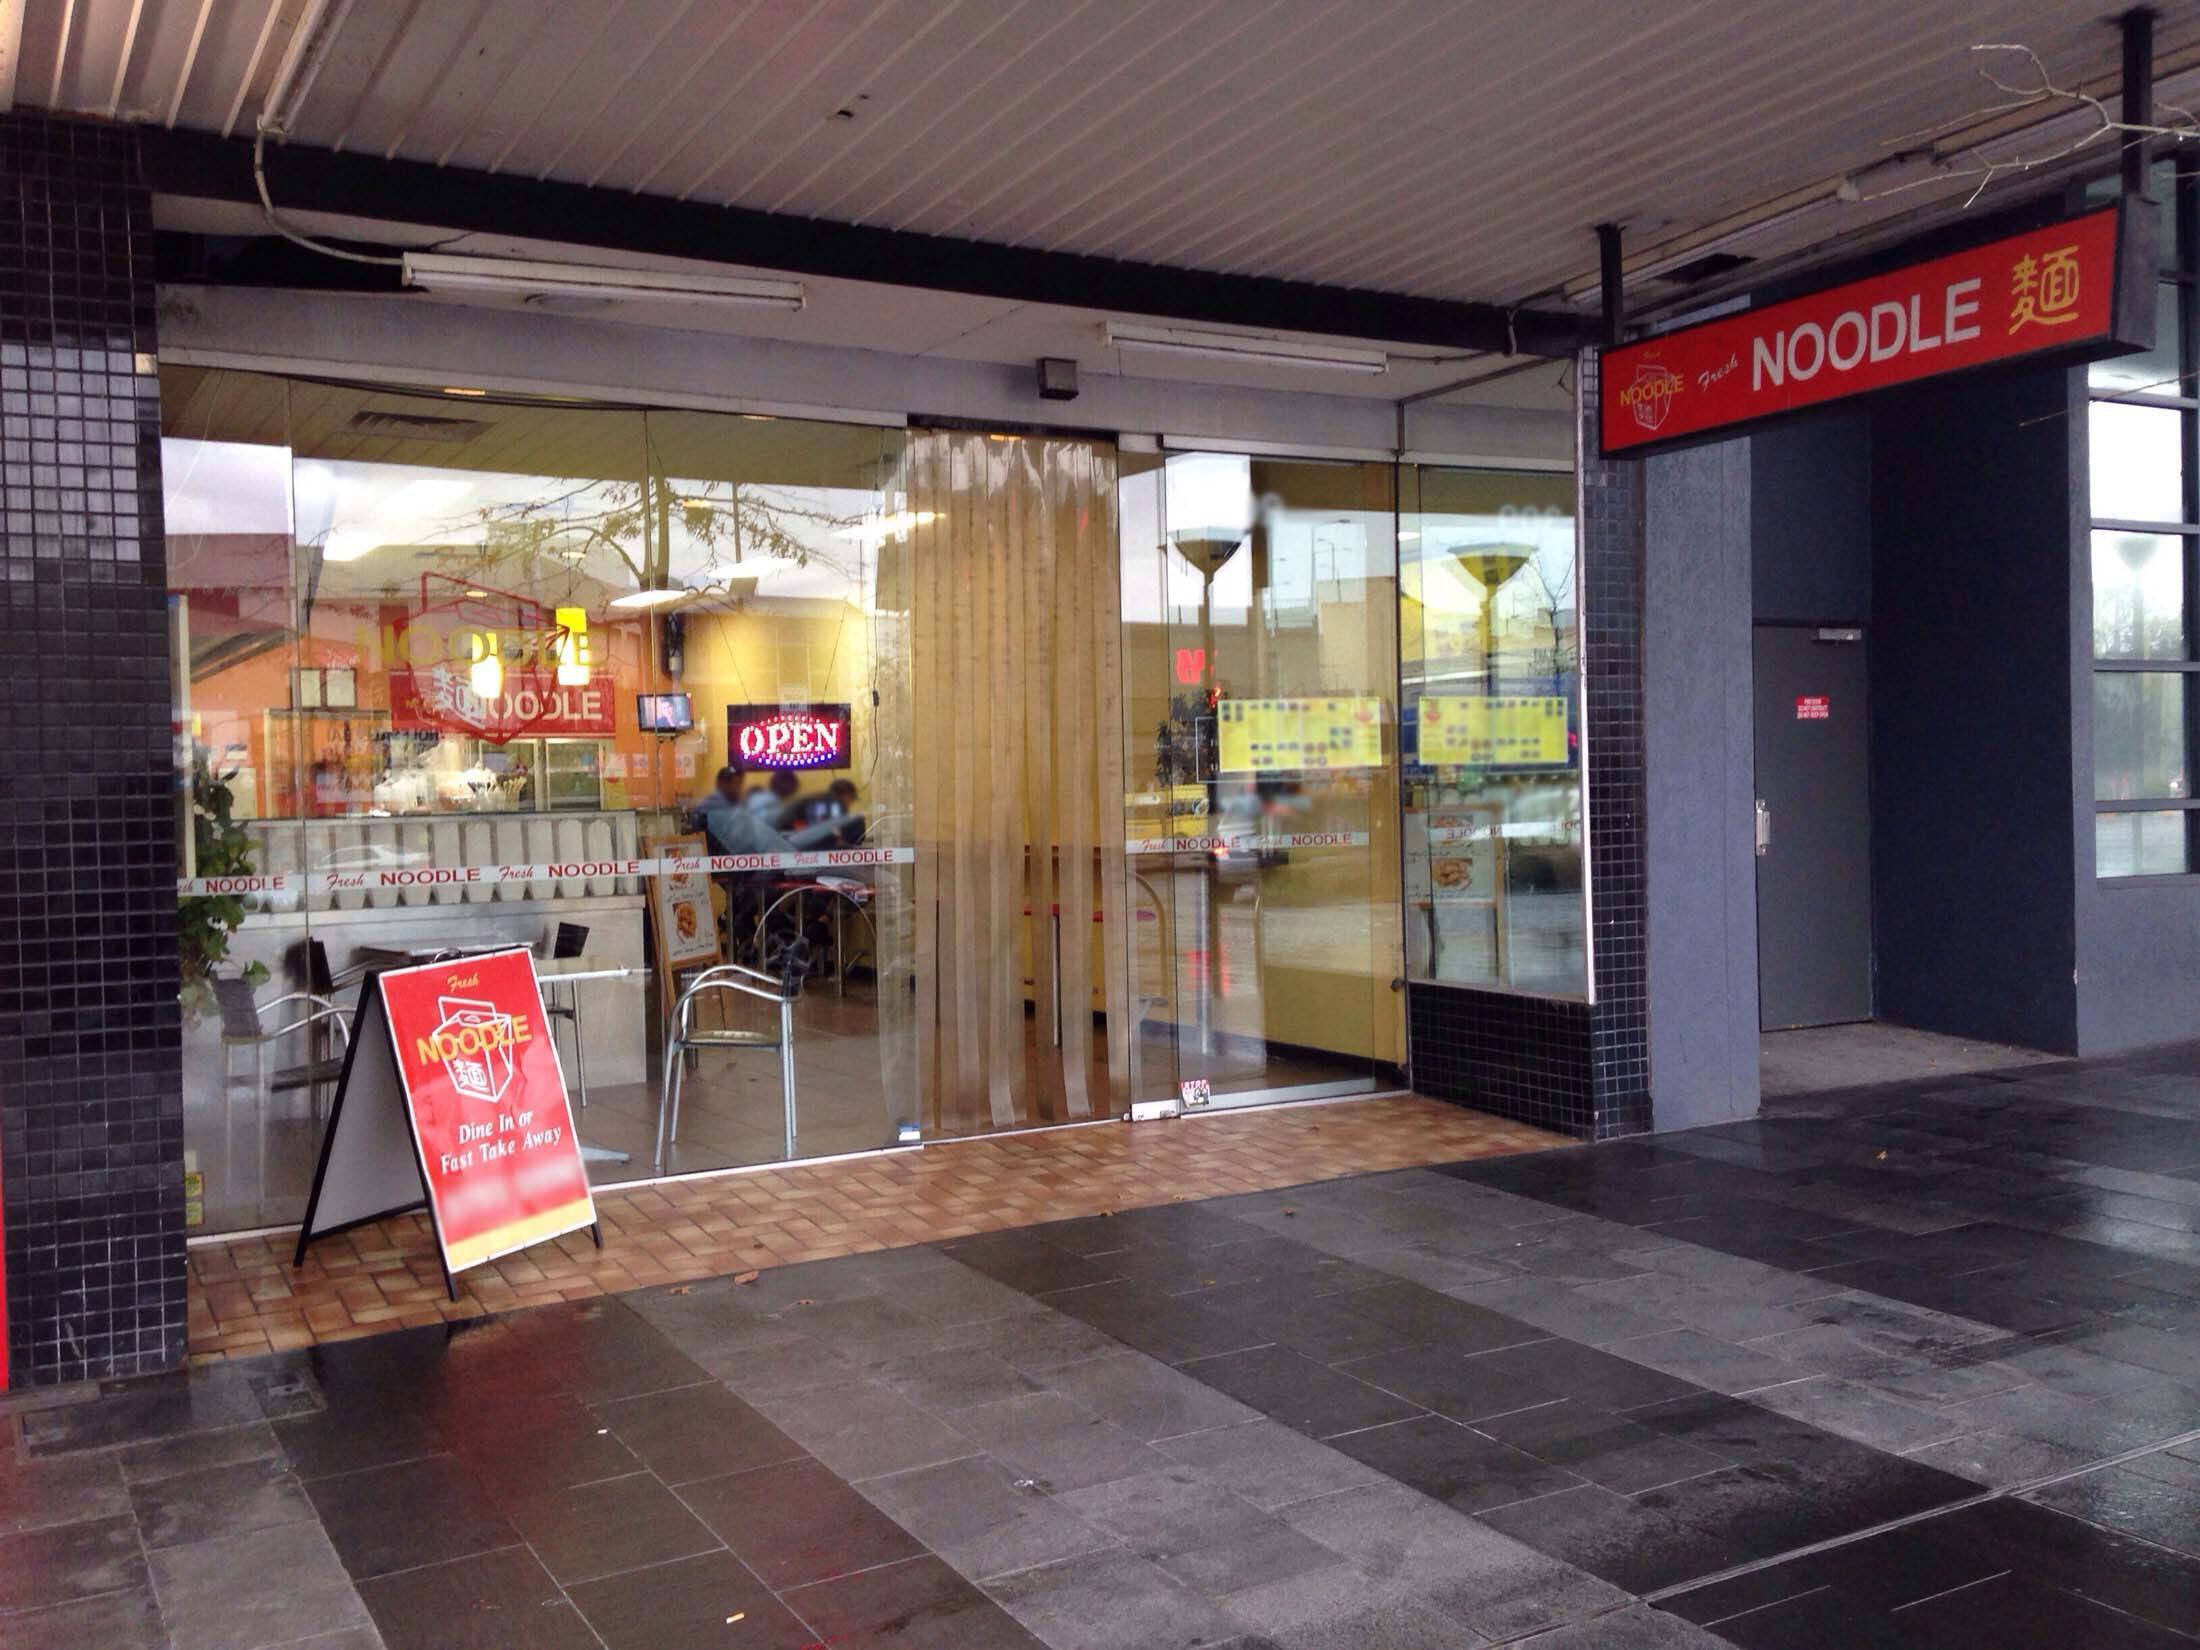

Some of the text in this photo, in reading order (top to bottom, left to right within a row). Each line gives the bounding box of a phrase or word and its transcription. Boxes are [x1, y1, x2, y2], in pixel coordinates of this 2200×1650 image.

[1698, 278, 1982, 392] Fresh NOODLE
[1620, 374, 1684, 407] NOODLE
[740, 722, 839, 756] OPEN
[1176, 835, 1241, 850] NOODLE
[1291, 833, 1351, 846] NOODLE
[205, 876, 285, 893] NOODLE
[326, 872, 365, 891] Fresh
[380, 868, 481, 886] NOODLE
[498, 865, 534, 883] Fresh
[548, 861, 641, 878] NOODLE
[673, 855, 702, 873] Fresh
[710, 855, 780, 870] NOODLE
[828, 850, 894, 864] NOODLE
[447, 973, 480, 993] Fresh
[416, 1014, 533, 1066] NOODLE
[458, 1110, 534, 1144] Dine In or
[440, 1126, 562, 1175] Fast Take Away
